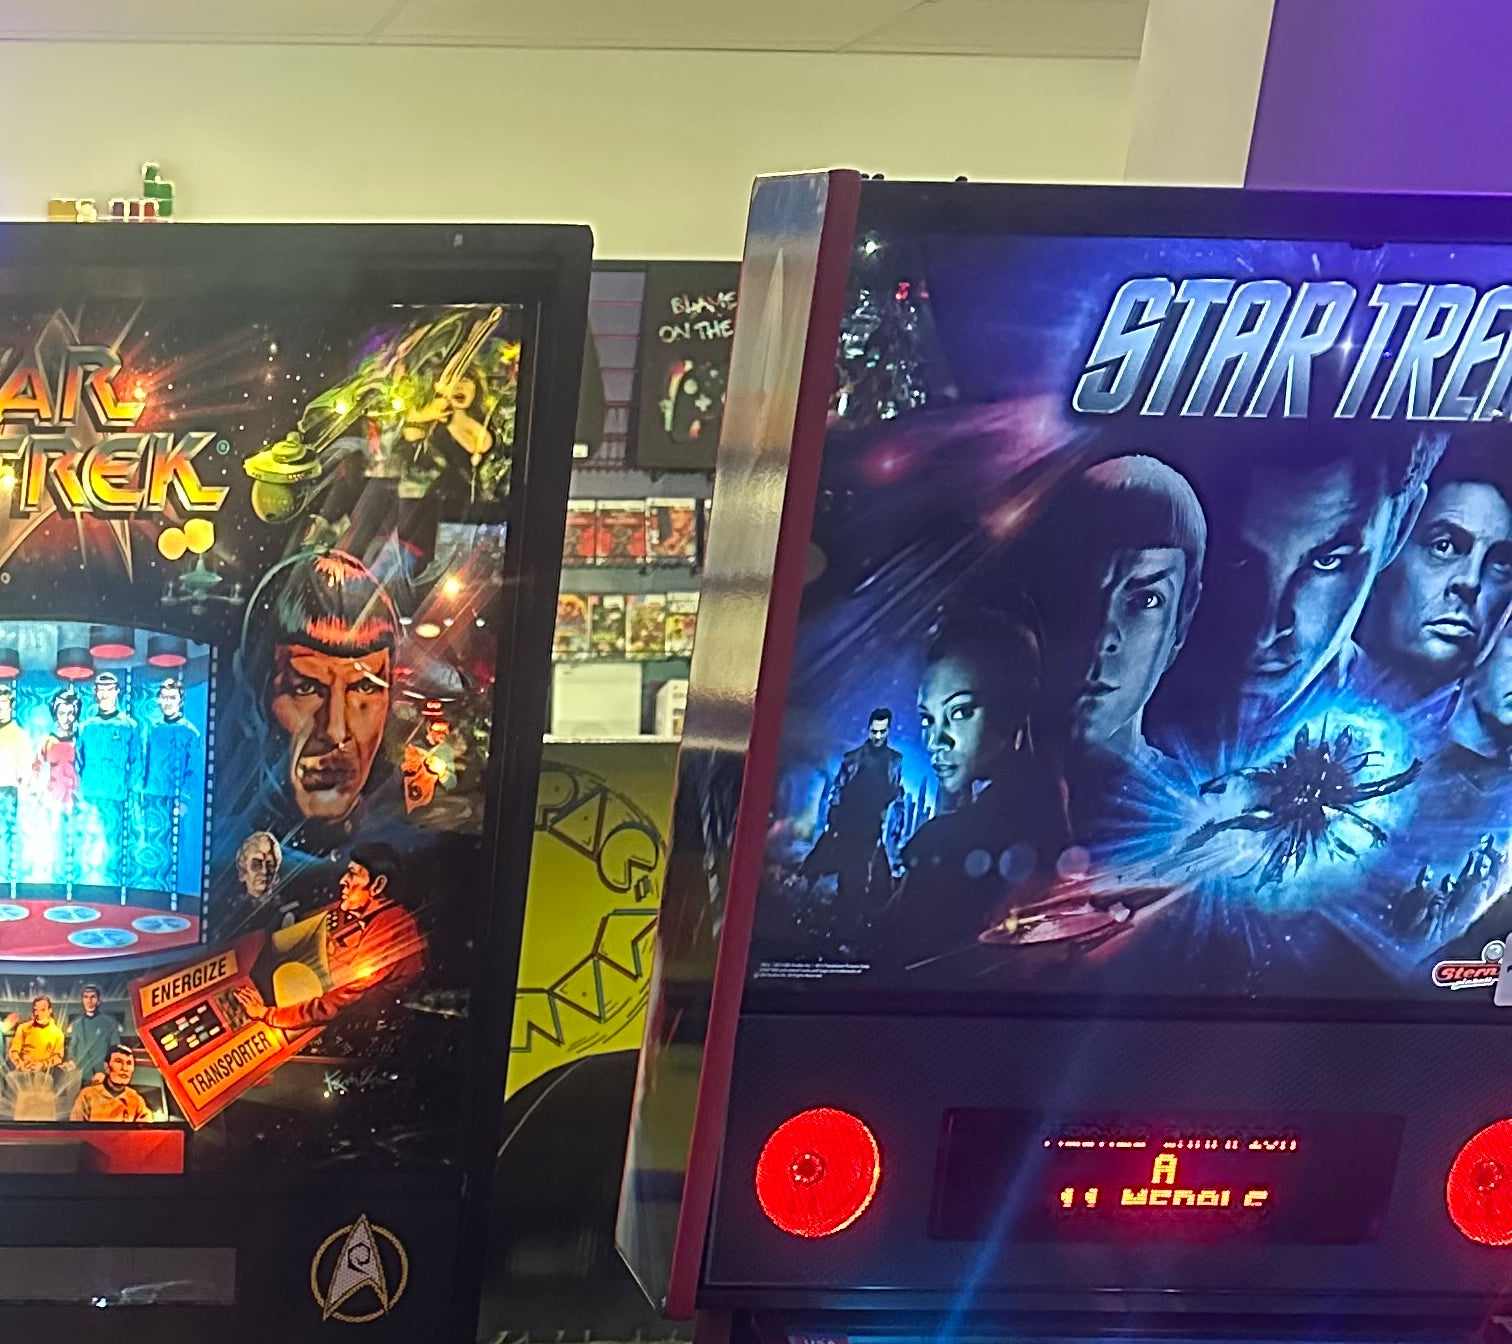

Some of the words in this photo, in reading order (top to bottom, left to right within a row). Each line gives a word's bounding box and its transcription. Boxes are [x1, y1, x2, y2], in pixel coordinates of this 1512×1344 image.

[658, 322, 691, 343] ON
[694, 319, 734, 340] THE
[1071, 277, 1357, 418] STAR
[151, 956, 228, 1007] ENERGIZE
[1441, 967, 1498, 980] Stern
[187, 1030, 272, 1097] TRANSPORTER
[1151, 1153, 1178, 1184] A
